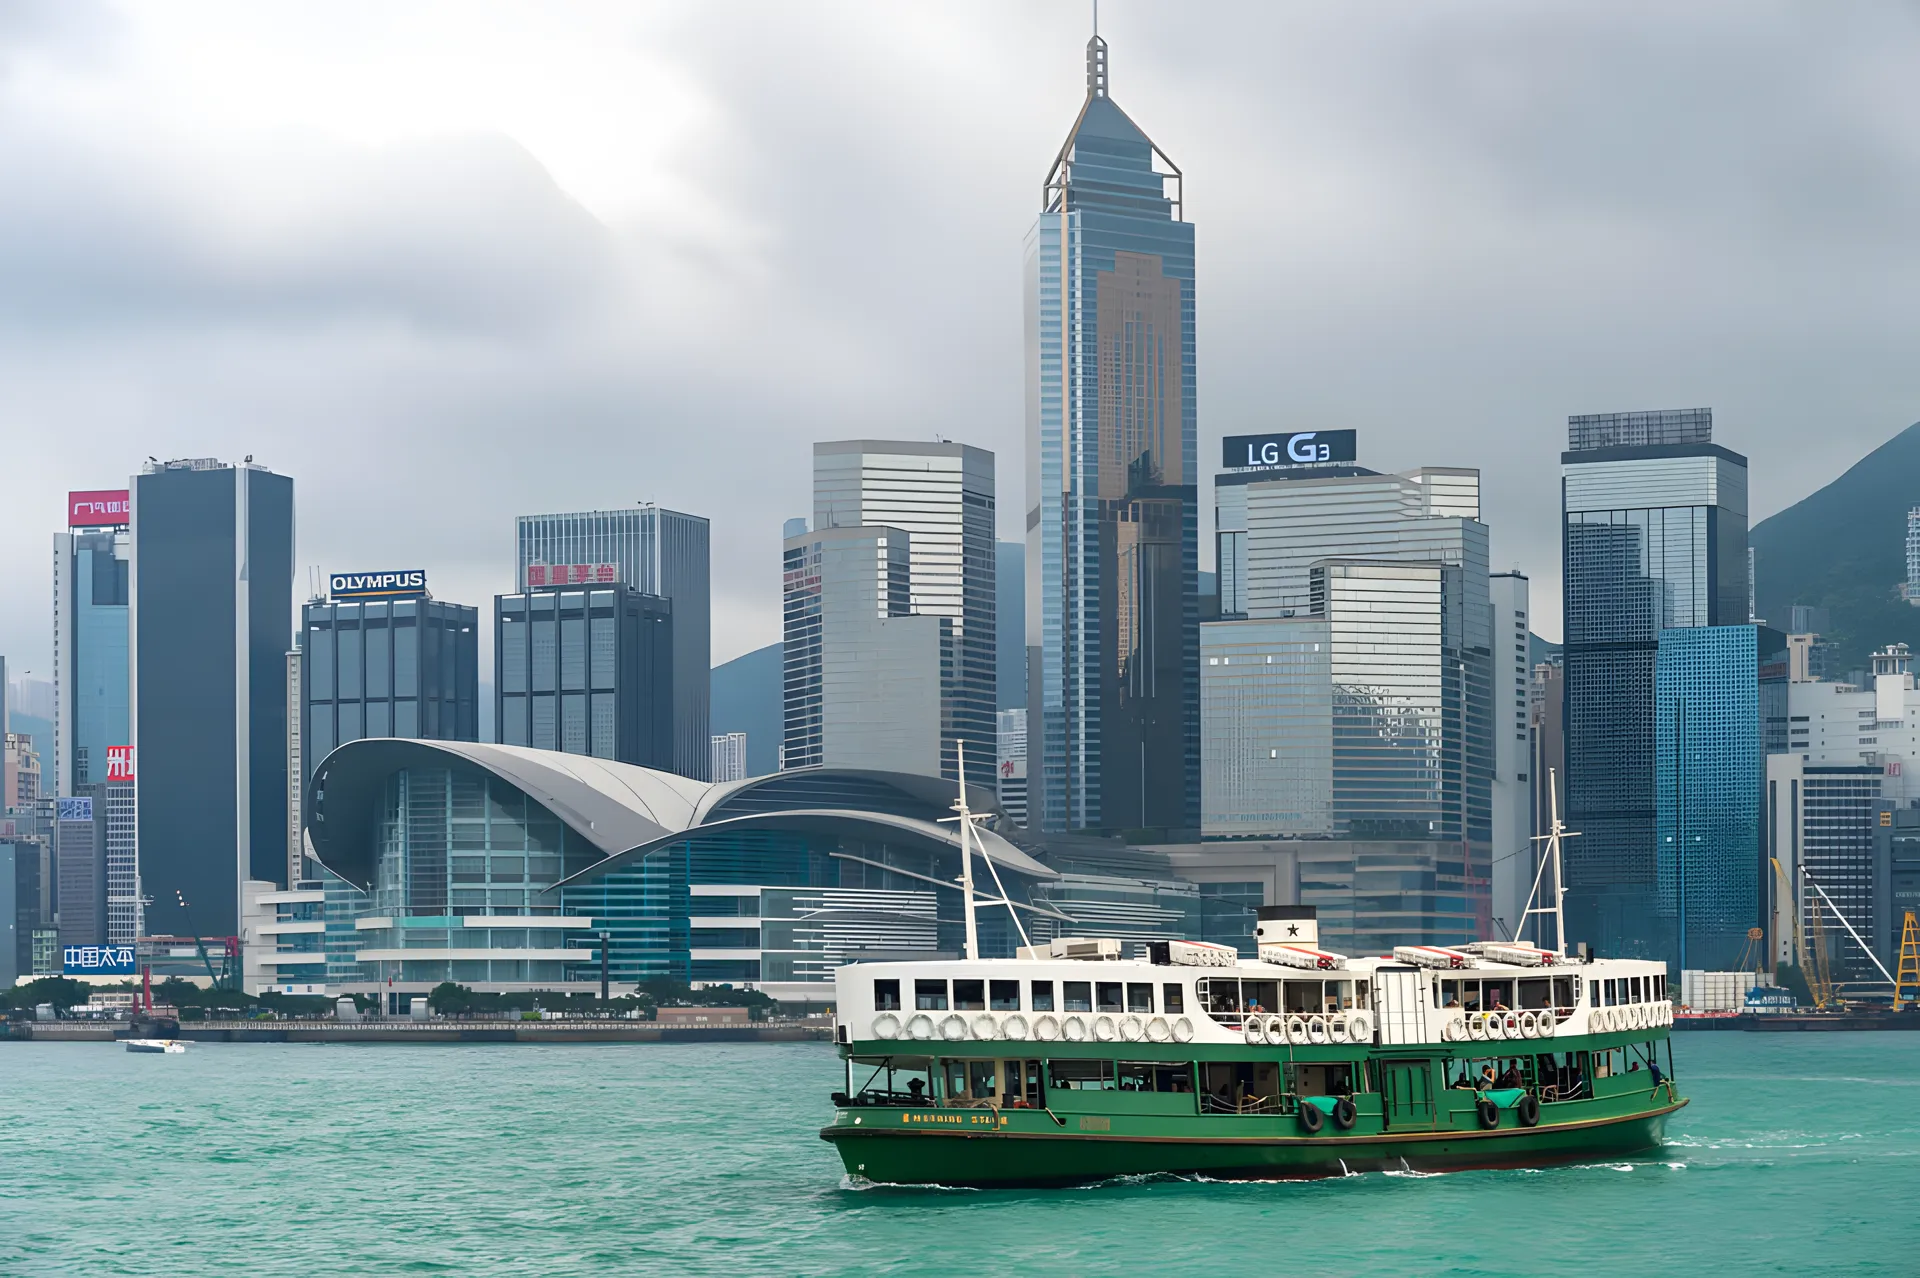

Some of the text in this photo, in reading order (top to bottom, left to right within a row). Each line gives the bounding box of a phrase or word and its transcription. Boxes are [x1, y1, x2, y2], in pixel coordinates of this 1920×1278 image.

[1247, 432, 1330, 466] LG G3
[332, 572, 423, 591] OLYMPUS
[64, 945, 134, 968] 中国太平
